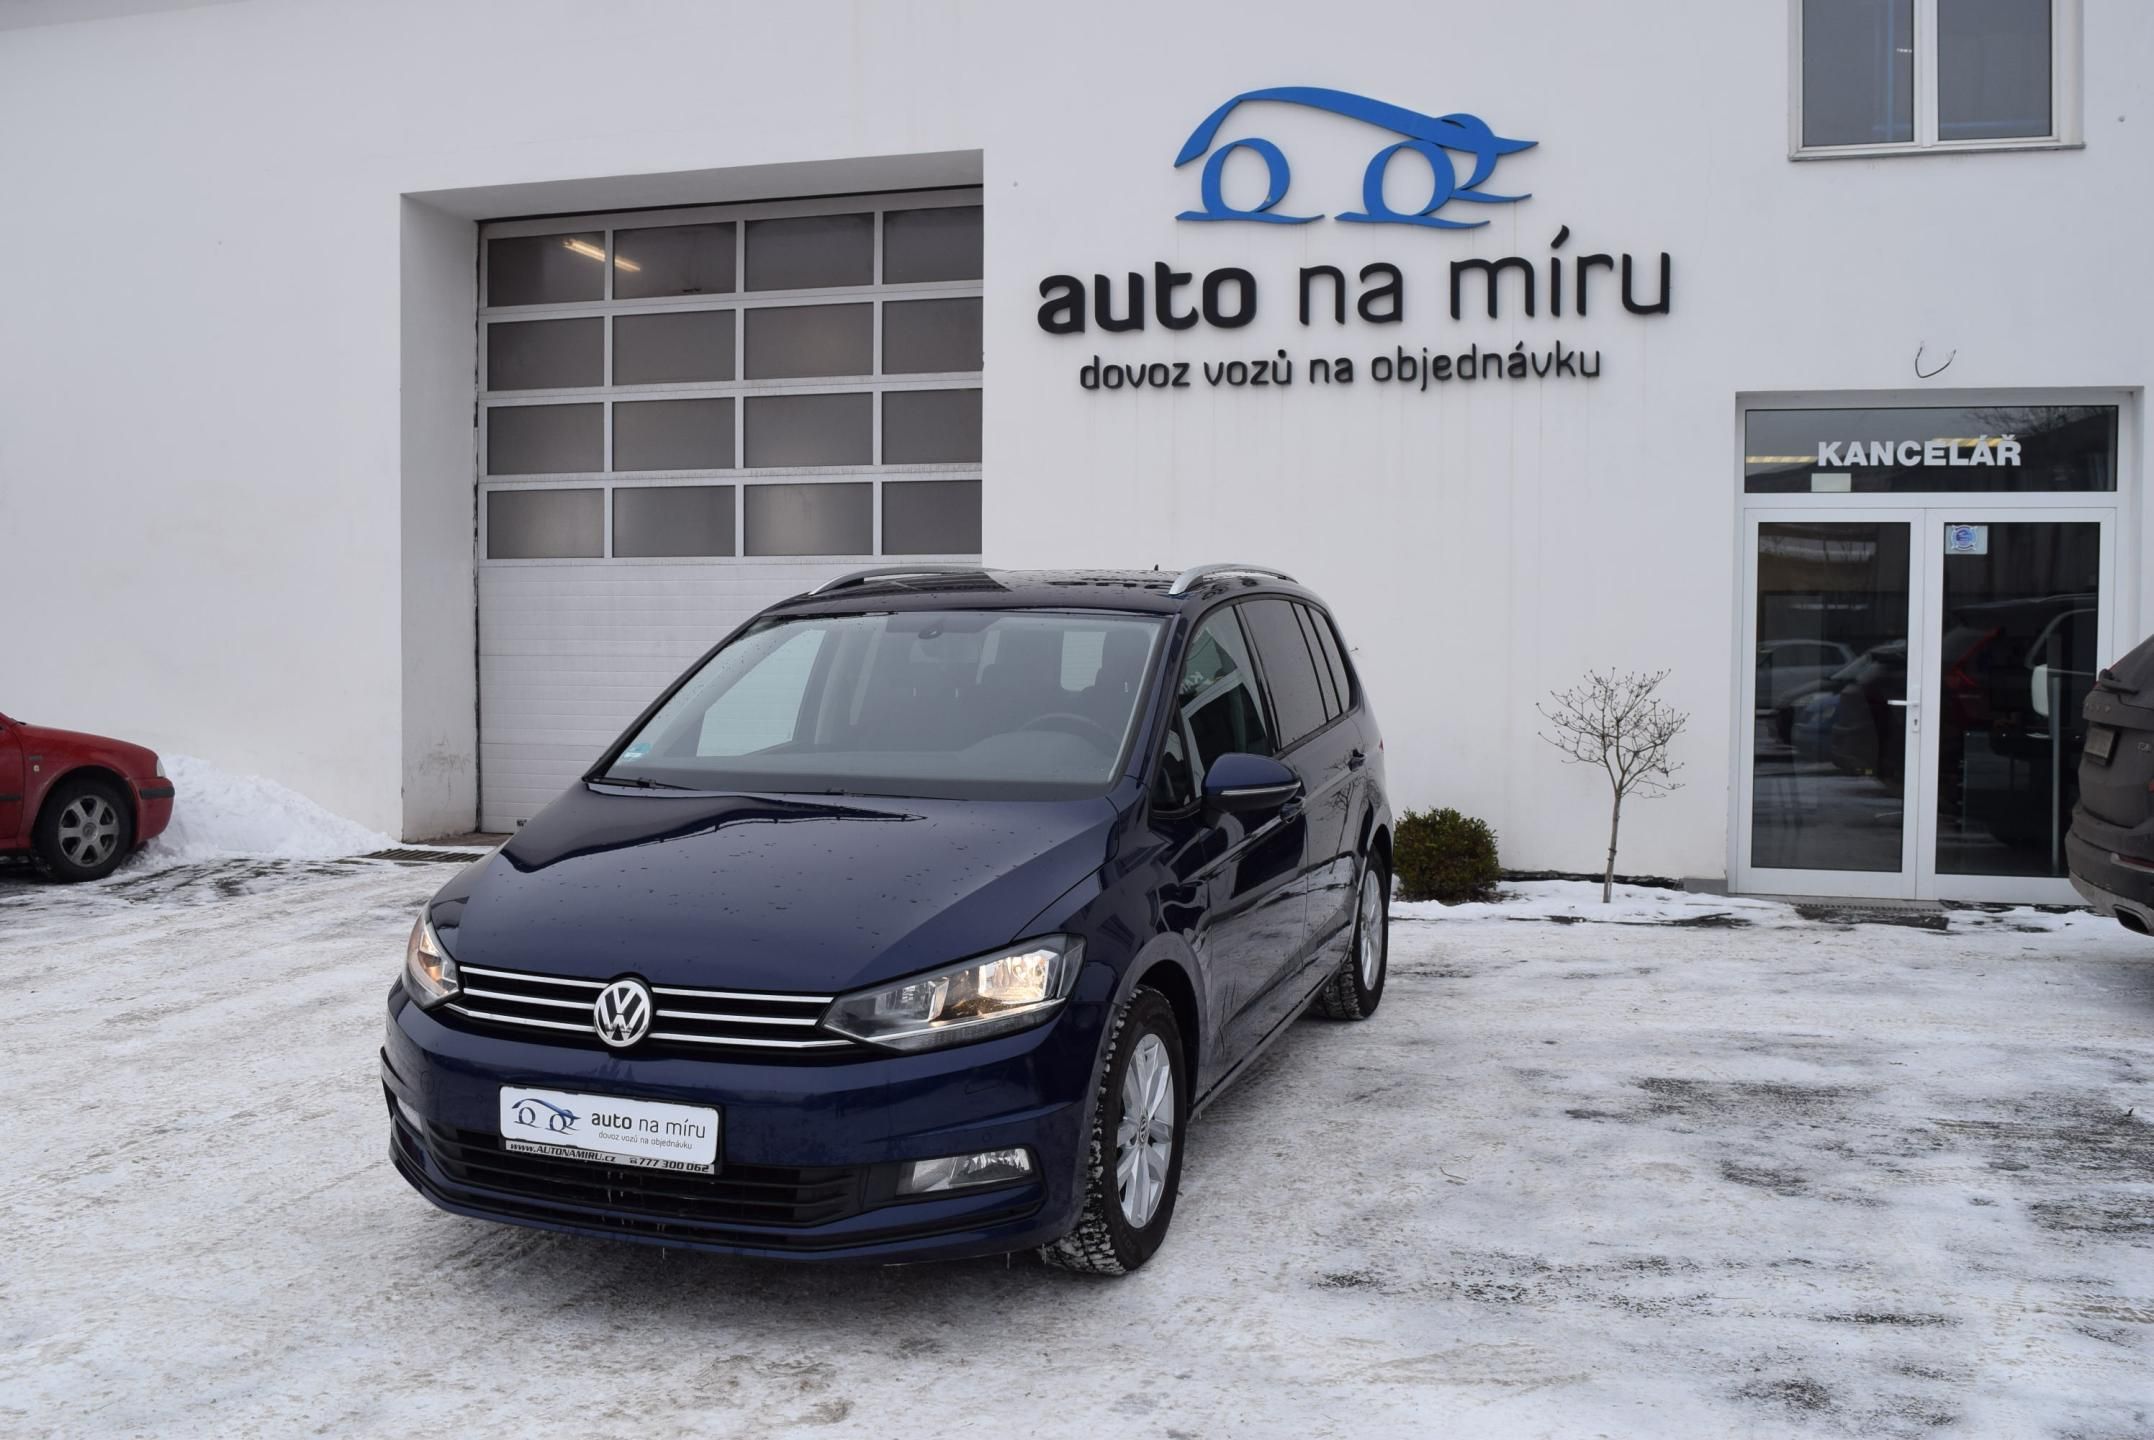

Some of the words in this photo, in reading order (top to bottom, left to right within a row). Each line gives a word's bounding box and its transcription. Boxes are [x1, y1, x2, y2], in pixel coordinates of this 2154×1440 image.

[1037, 261, 1257, 334] auto
[1299, 261, 1403, 326] na
[1450, 225, 1671, 320] míru
[1080, 355, 1190, 390] dovoz
[1204, 348, 1292, 387] vozů
[1309, 356, 1353, 384] na
[1371, 341, 1601, 391] objednávku
[1817, 434, 2022, 466] KANCELÁŘ
[591, 1112, 632, 1130] auto
[639, 1118, 659, 1133] na
[665, 1118, 706, 1138] míru
[598, 1131, 619, 1141] dovoz
[621, 1134, 638, 1143] vozů
[640, 1137, 649, 1145] na
[651, 1138, 693, 1150] objednávku
[639, 1157, 660, 1167] 777
[661, 1160, 684, 1170] 300
